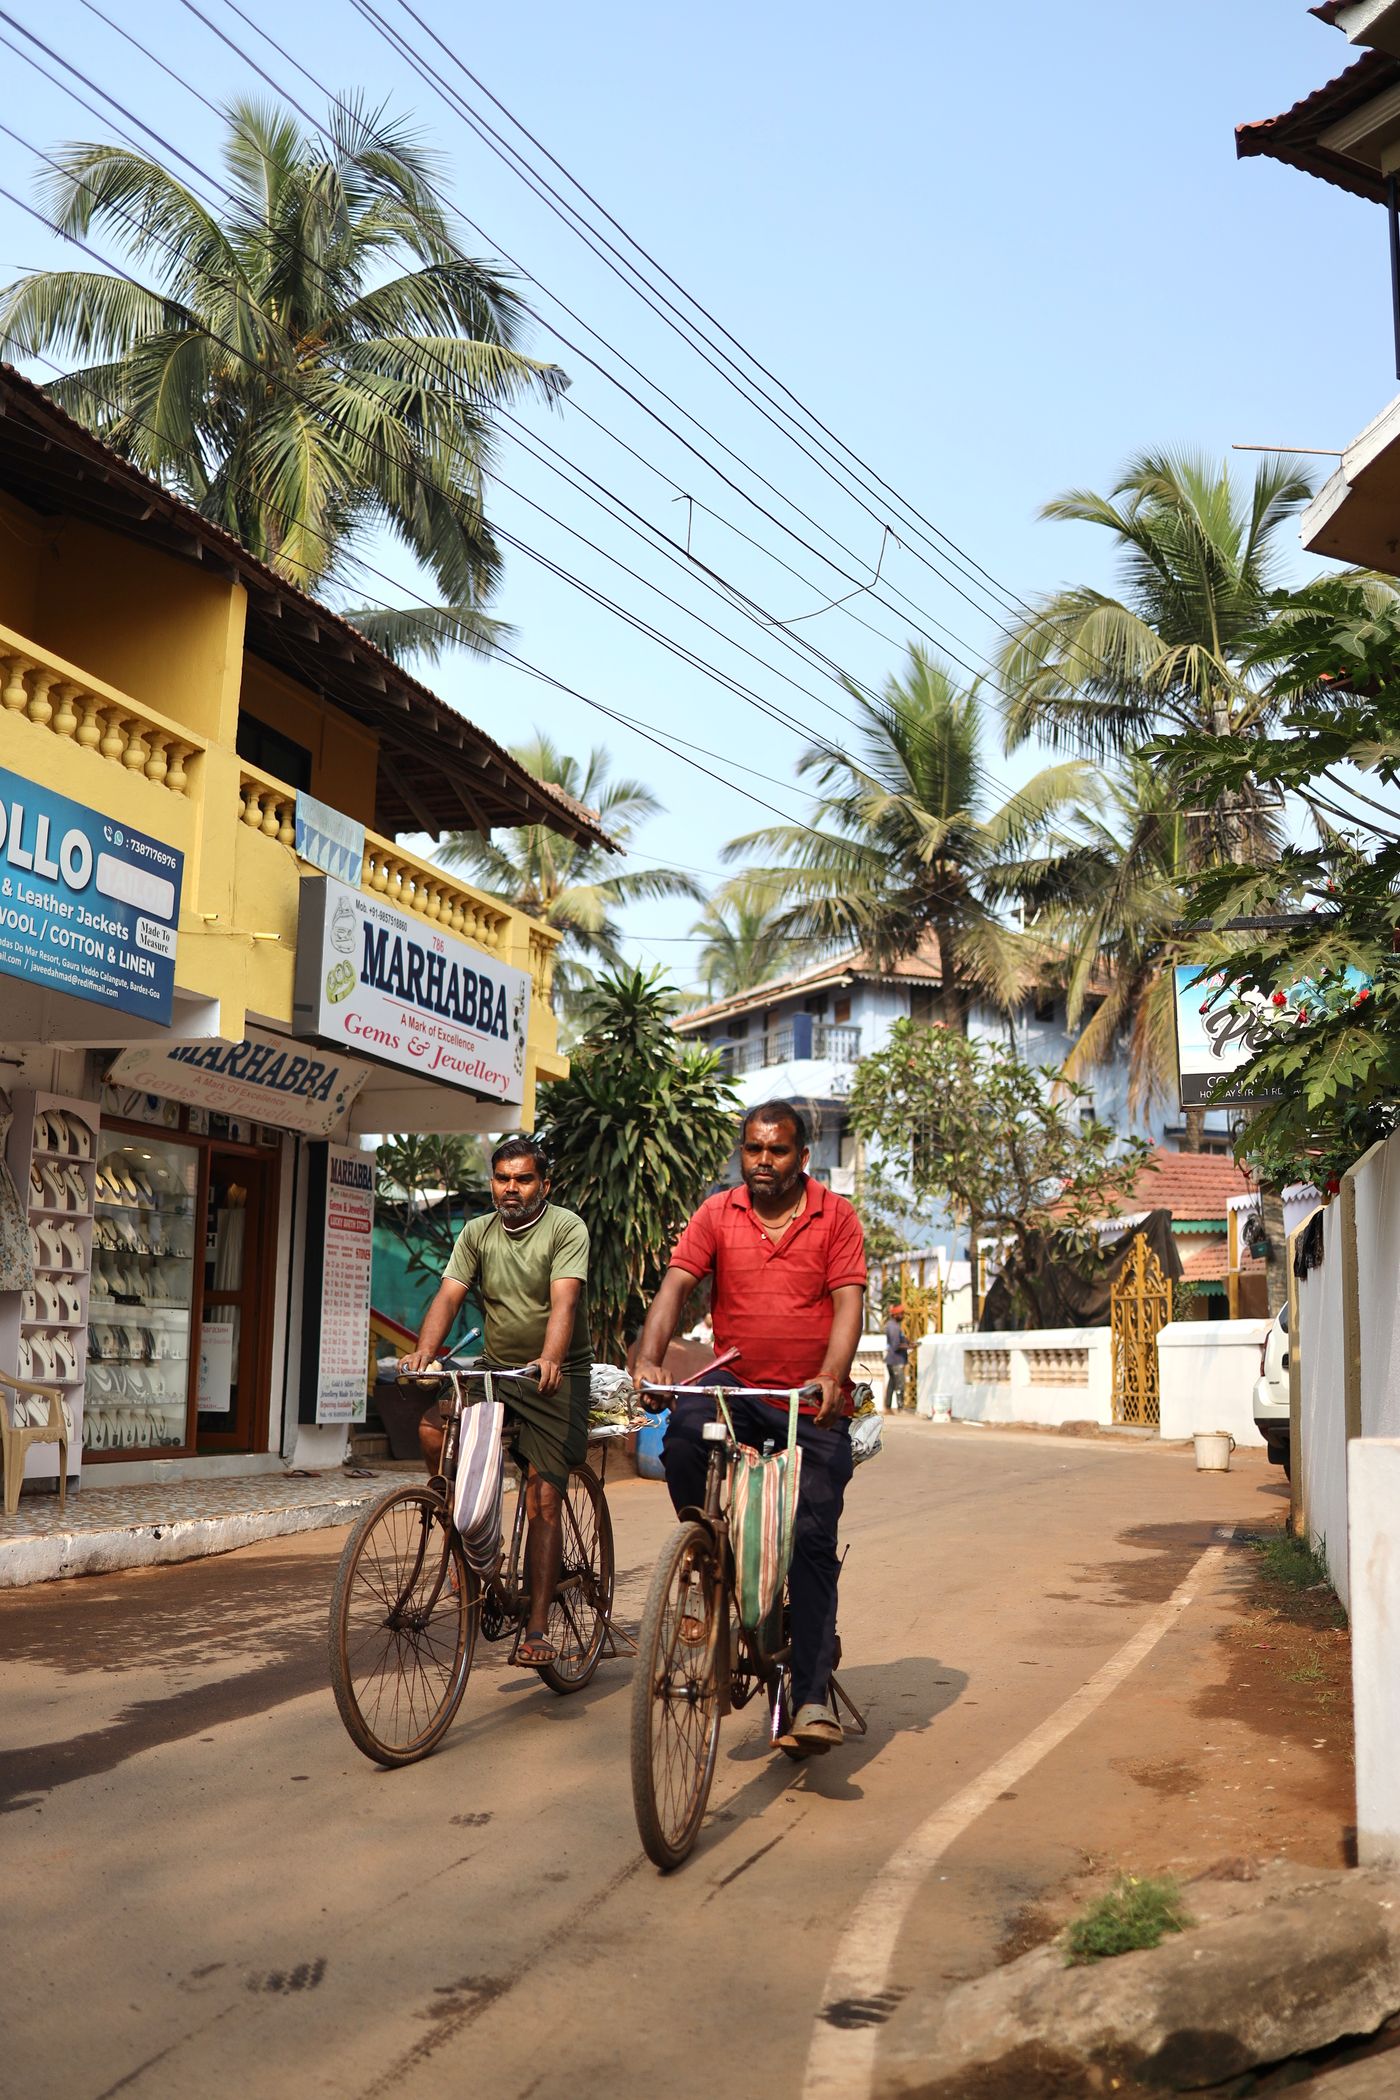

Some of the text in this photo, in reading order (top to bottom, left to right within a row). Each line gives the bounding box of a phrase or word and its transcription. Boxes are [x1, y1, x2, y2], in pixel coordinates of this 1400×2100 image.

[0, 799, 93, 890] LLO
[130, 838, 176, 869] 7387176976
[2, 878, 128, 940] & Leather Jackets
[355, 899, 369, 914] Mob.
[140, 935, 168, 953] Measure
[141, 921, 170, 943] Made To
[432, 936, 444, 952] 786
[15, 942, 23, 952] Do
[25, 945, 38, 956] Mar
[40, 951, 60, 966] Resort,
[62, 958, 80, 971] Gaura
[81, 963, 99, 978] Vaddo
[100, 971, 129, 989] Calangute,
[50, 925, 104, 957] COTTON
[107, 947, 116, 964] &
[119, 951, 155, 978] LINEN
[360, 921, 509, 1041] MARHABBA
[344, 1012, 510, 1092] Gems & Jewellery
[401, 1014, 474, 1052] A Mark of Excellence
[135, 1072, 319, 1129] Gems & Jewellery
[193, 1076, 201, 1084] A
[203, 1078, 225, 1090] Mark
[240, 1088, 286, 1106] Excellence
[330, 1157, 372, 1191] MARHABBA
